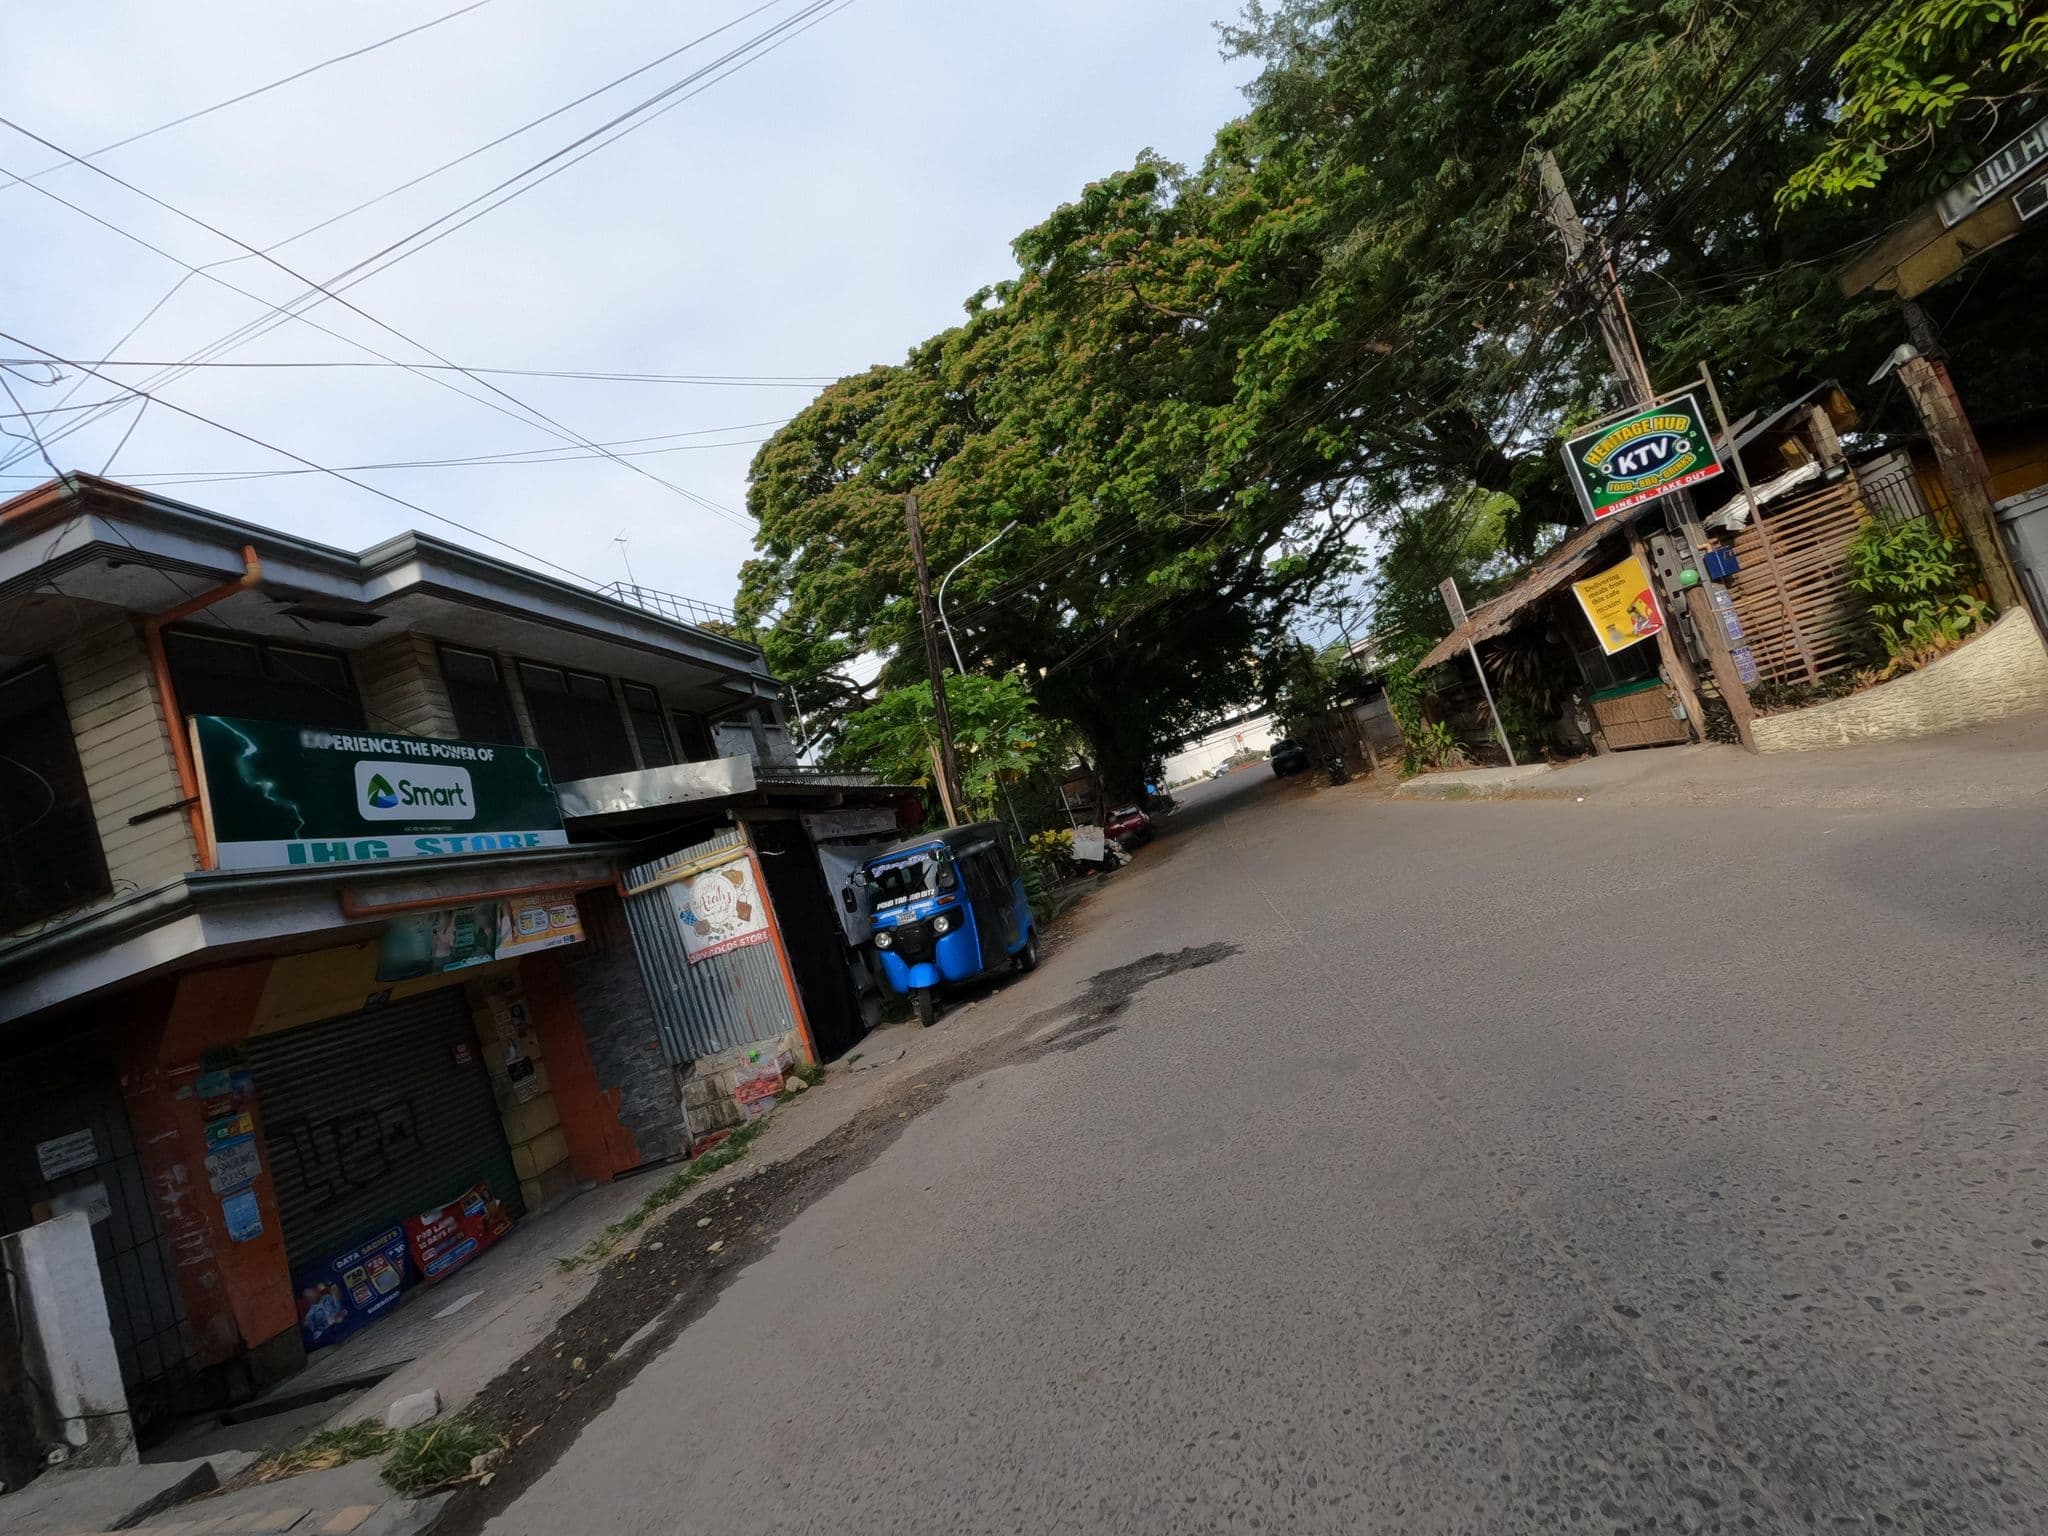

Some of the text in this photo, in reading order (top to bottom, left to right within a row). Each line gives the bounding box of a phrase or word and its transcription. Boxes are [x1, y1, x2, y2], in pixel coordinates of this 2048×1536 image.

[1584, 416, 1689, 465] HERITAGE HUB
[1617, 437, 1668, 475] KTV
[1608, 470, 1706, 512] DINE IN TAKE OUT
[1584, 573, 1621, 593] Delivering
[1588, 578, 1627, 599] meals from
[1591, 589, 1621, 606] this cafe
[400, 740, 430, 757] THE
[431, 743, 477, 760] POWER
[477, 748, 495, 761] OF
[398, 779, 467, 807] Smart
[739, 931, 769, 946] STORE
[336, 1251, 360, 1269] DATA
